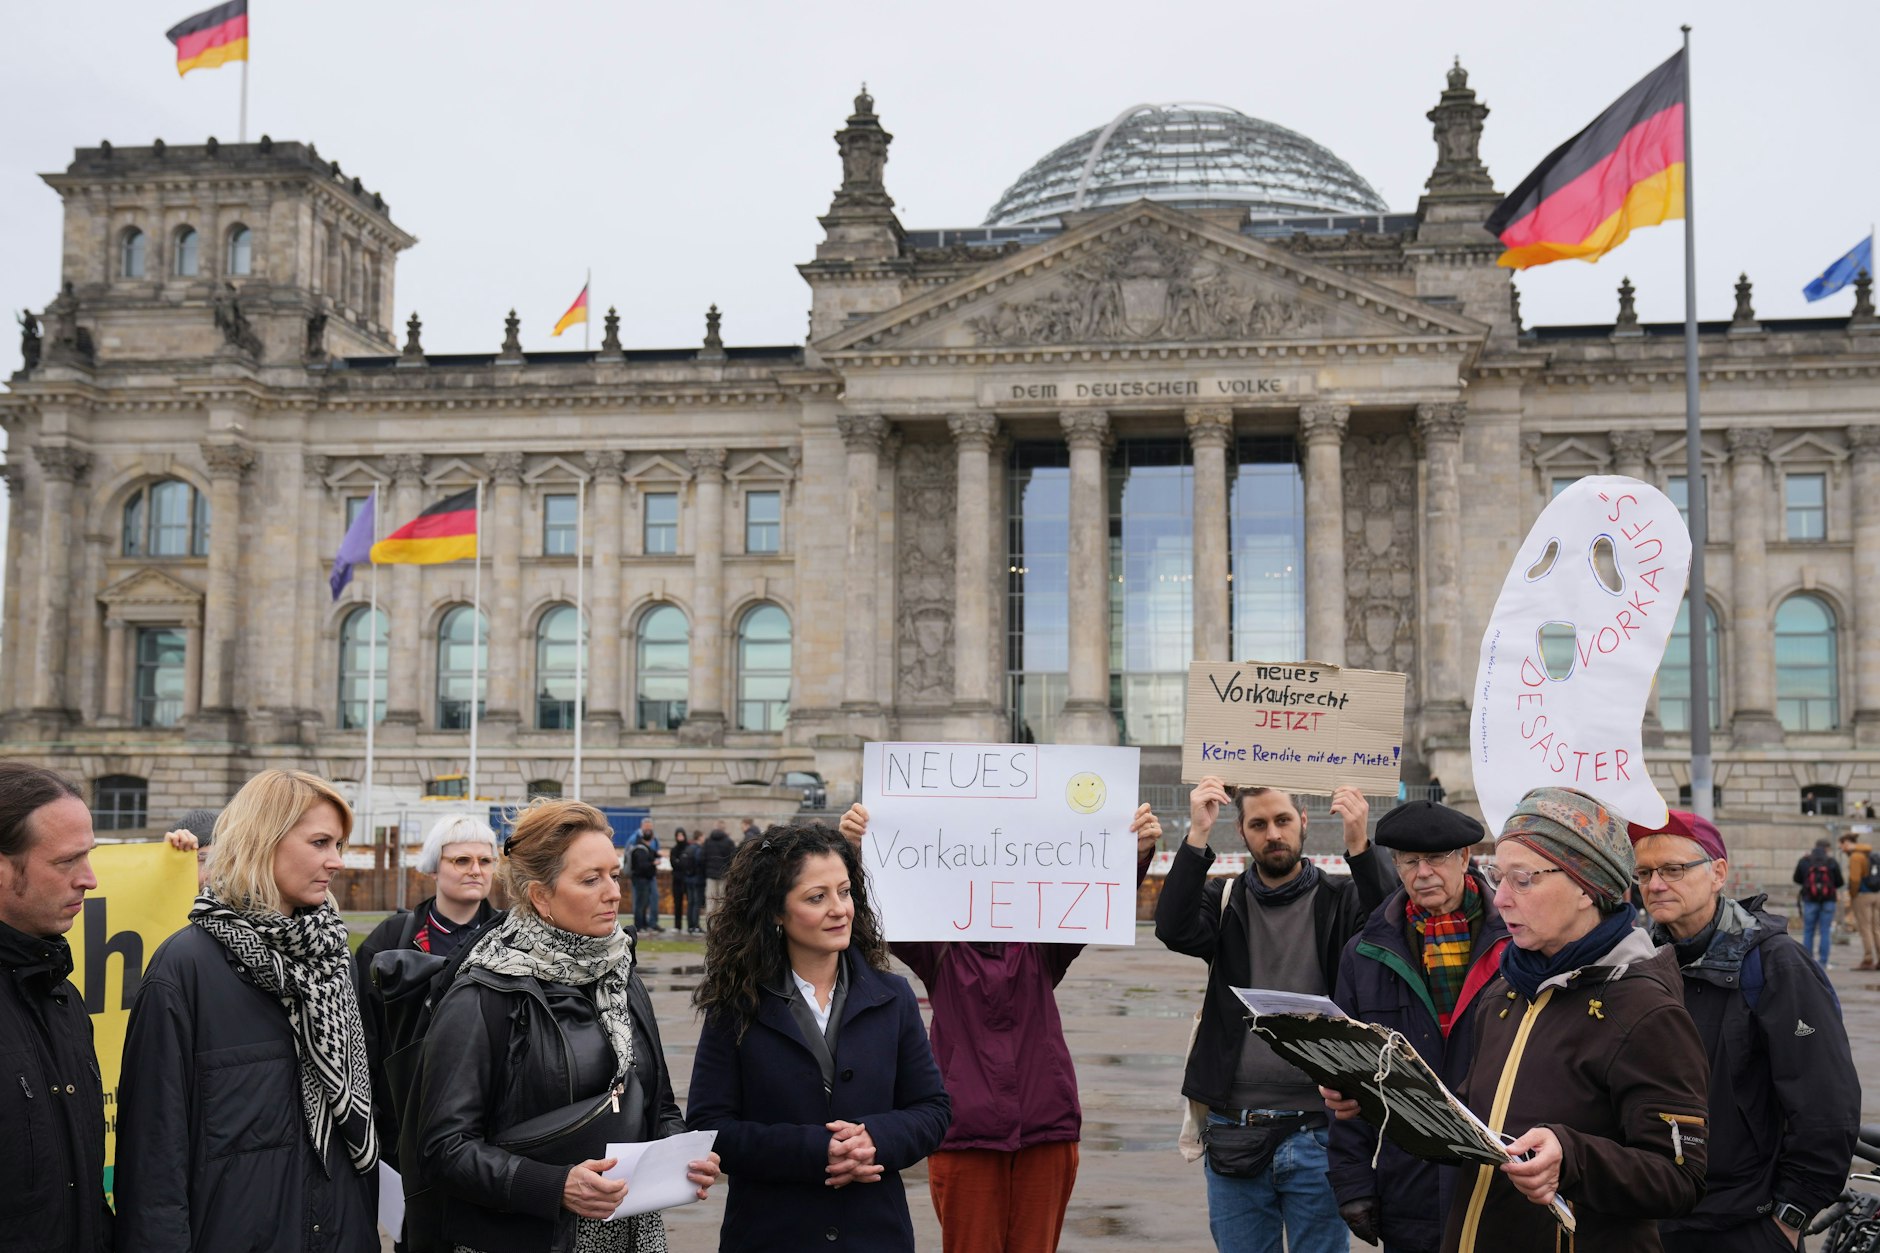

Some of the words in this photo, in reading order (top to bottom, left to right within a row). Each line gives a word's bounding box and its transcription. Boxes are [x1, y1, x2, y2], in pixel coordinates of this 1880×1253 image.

[1012, 384, 1058, 399] DEM
[1076, 381, 1199, 397] DEUTSCHEN
[1217, 378, 1282, 394] VOLKE
[1208, 670, 1350, 710] Vorkaufsrecht
[1256, 665, 1320, 683] neues
[1255, 710, 1327, 732] JETZT
[1517, 655, 1631, 782] DESASTER
[888, 751, 1029, 791] NEUES
[1253, 744, 1301, 763] Rendite
[1307, 751, 1326, 764] mit
[1327, 751, 1348, 765] der
[1353, 746, 1401, 767] Miete!
[871, 828, 1111, 871] Vorkaufsrecht
[952, 880, 1121, 931] JETZT
